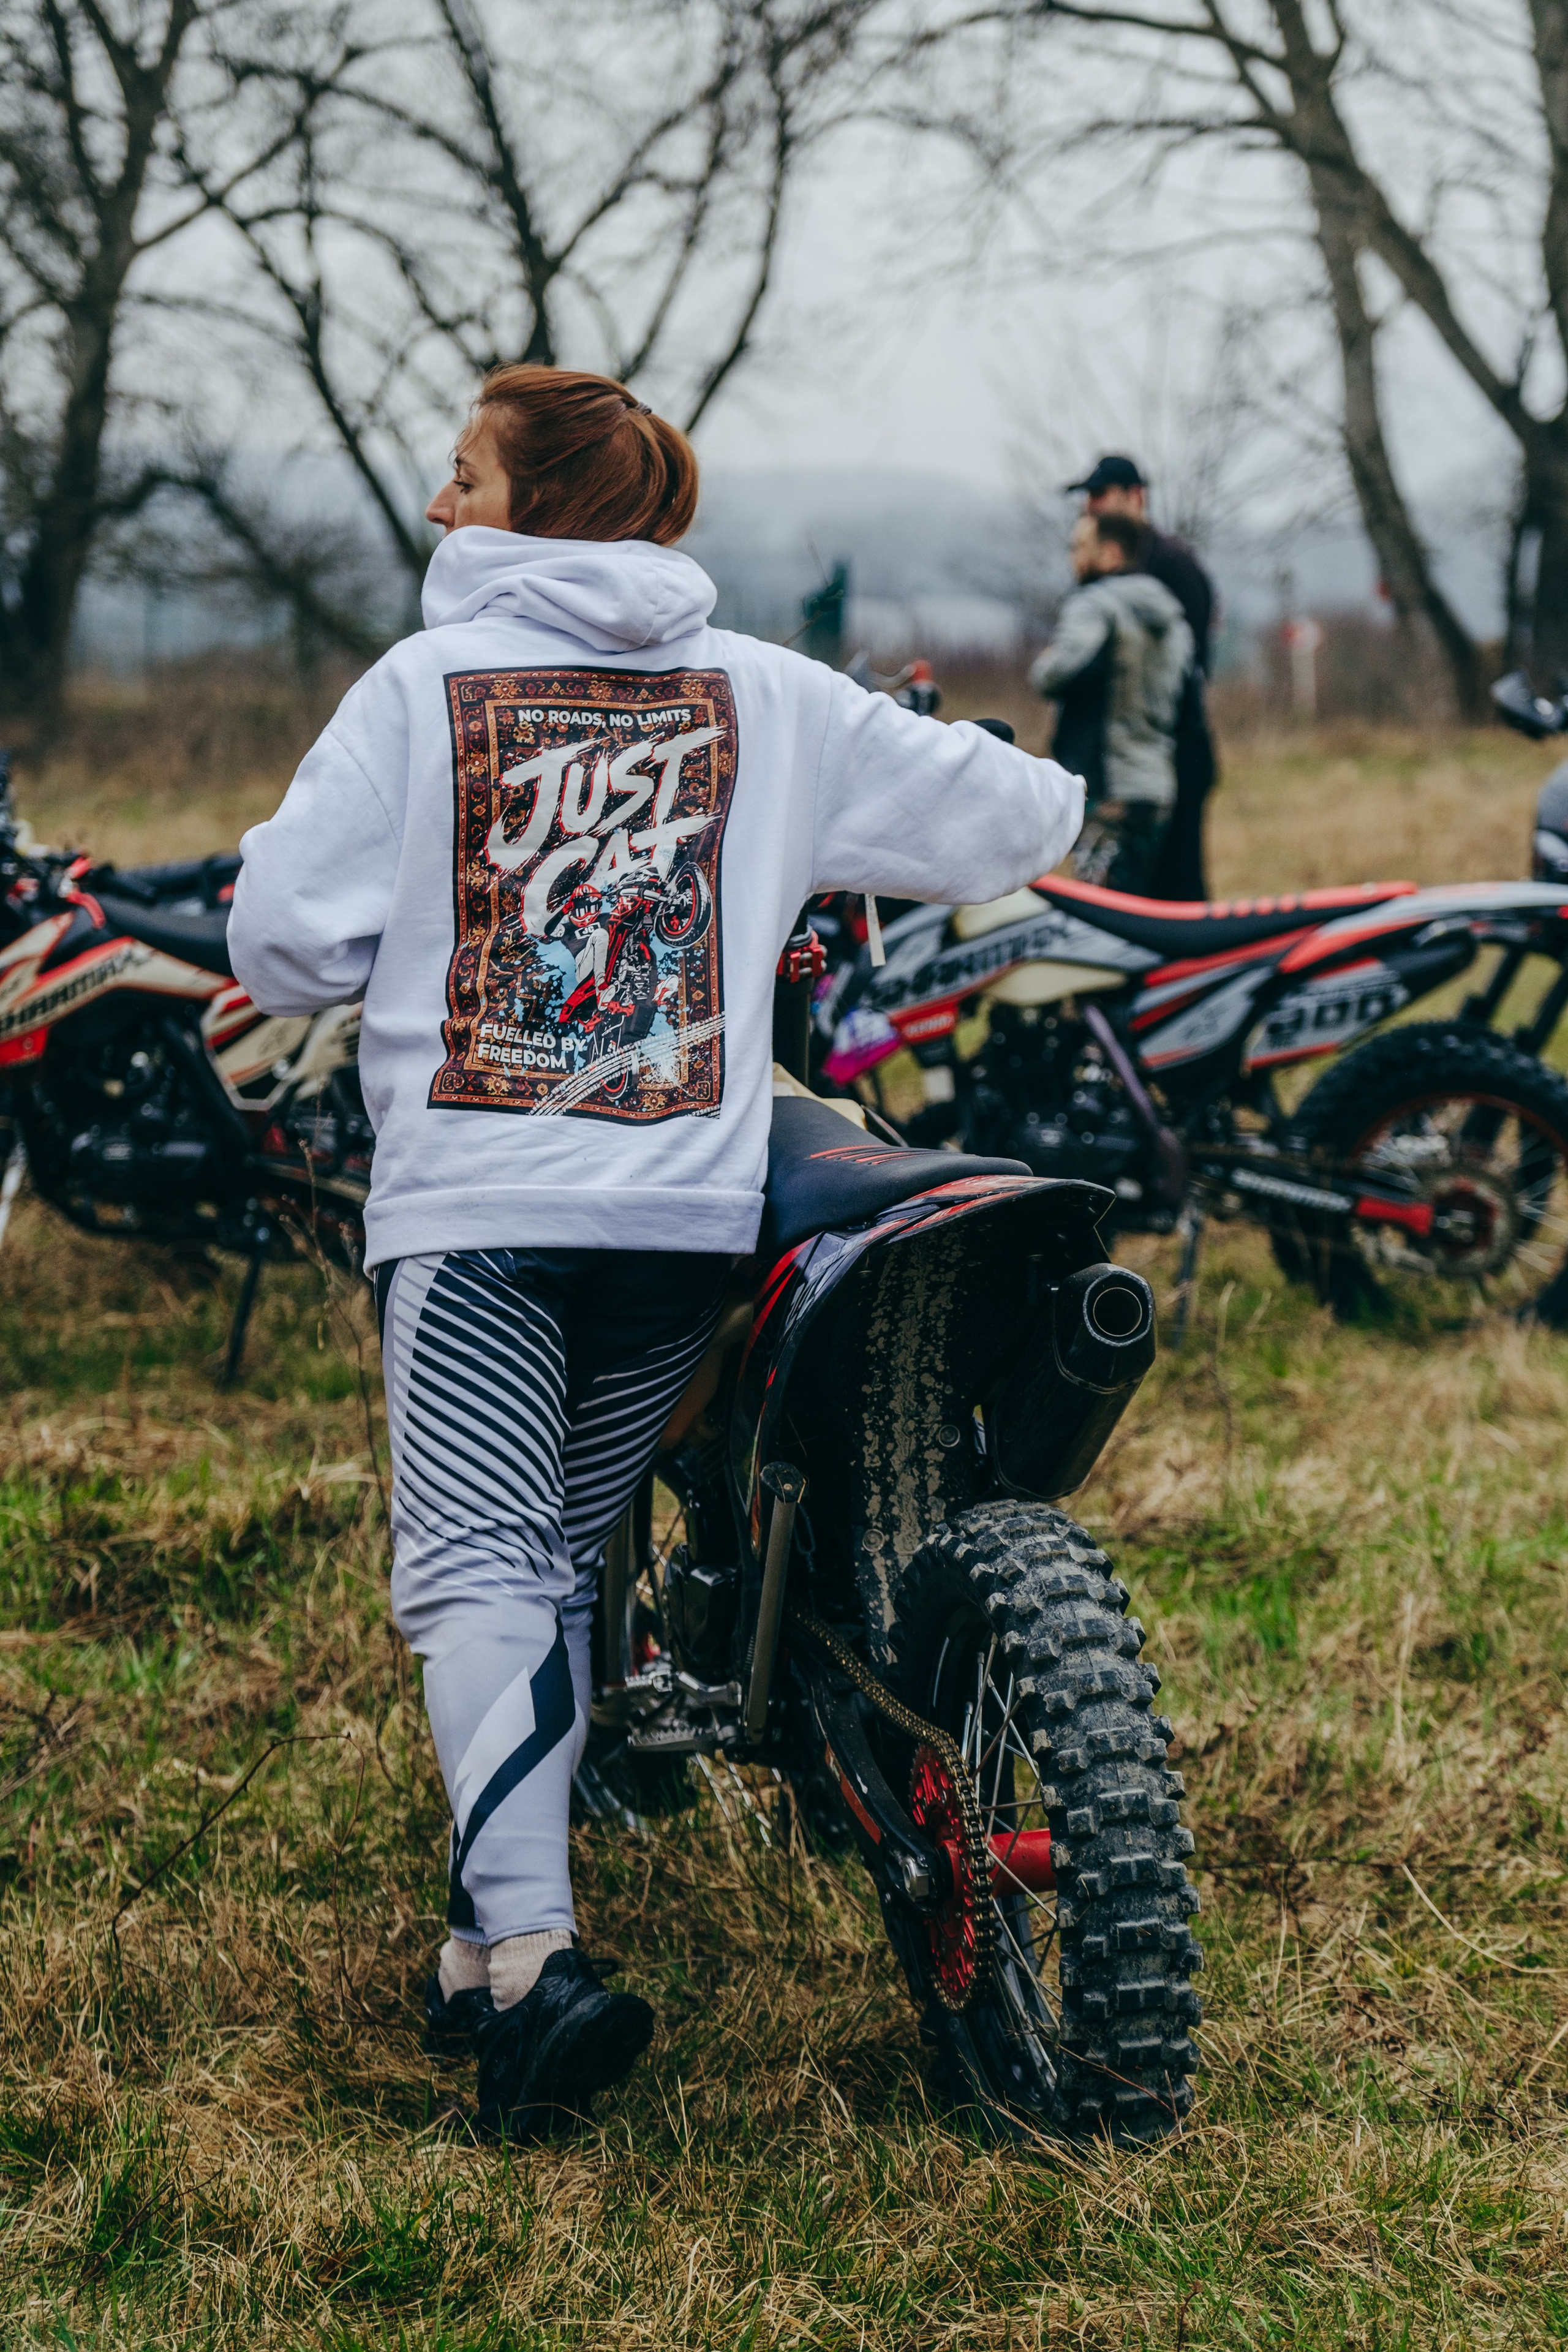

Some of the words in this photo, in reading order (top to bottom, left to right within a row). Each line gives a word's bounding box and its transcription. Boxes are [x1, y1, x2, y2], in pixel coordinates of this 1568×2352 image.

[518, 709, 544, 723] NO
[548, 710, 606, 729] ROADS,
[609, 713, 633, 727] NO
[636, 709, 692, 725] LIMITS
[486, 726, 728, 872] JUST
[521, 813, 725, 936] CAT
[582, 925, 594, 934] JC
[480, 1023, 556, 1049] FUELLED
[561, 1036, 586, 1052] BY
[477, 1043, 567, 1069] FREEDOM
